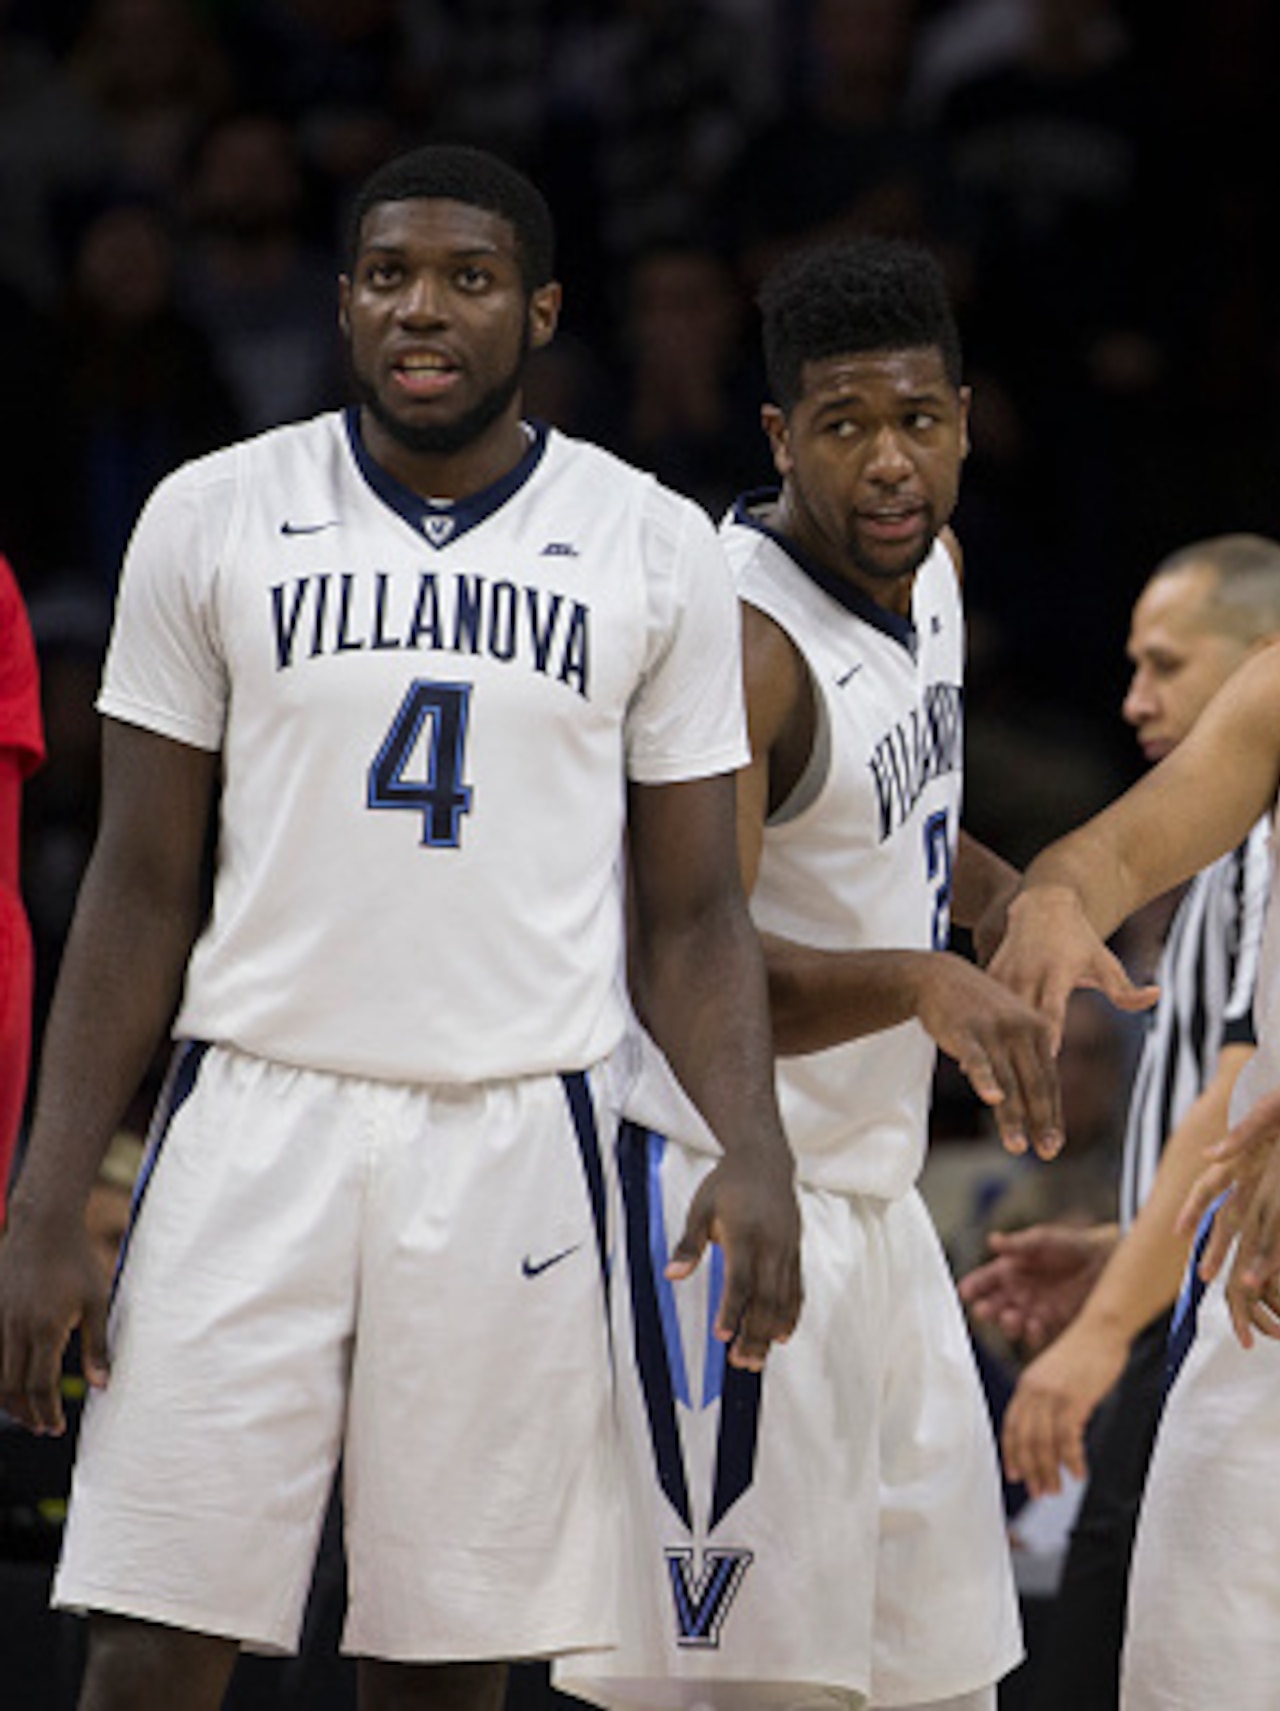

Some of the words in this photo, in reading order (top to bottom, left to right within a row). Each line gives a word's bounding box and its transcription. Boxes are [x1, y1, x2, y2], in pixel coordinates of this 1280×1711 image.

[269, 573, 590, 701] VILLANOVA
[366, 677, 474, 849] 4
[663, 1547, 754, 1650] V
